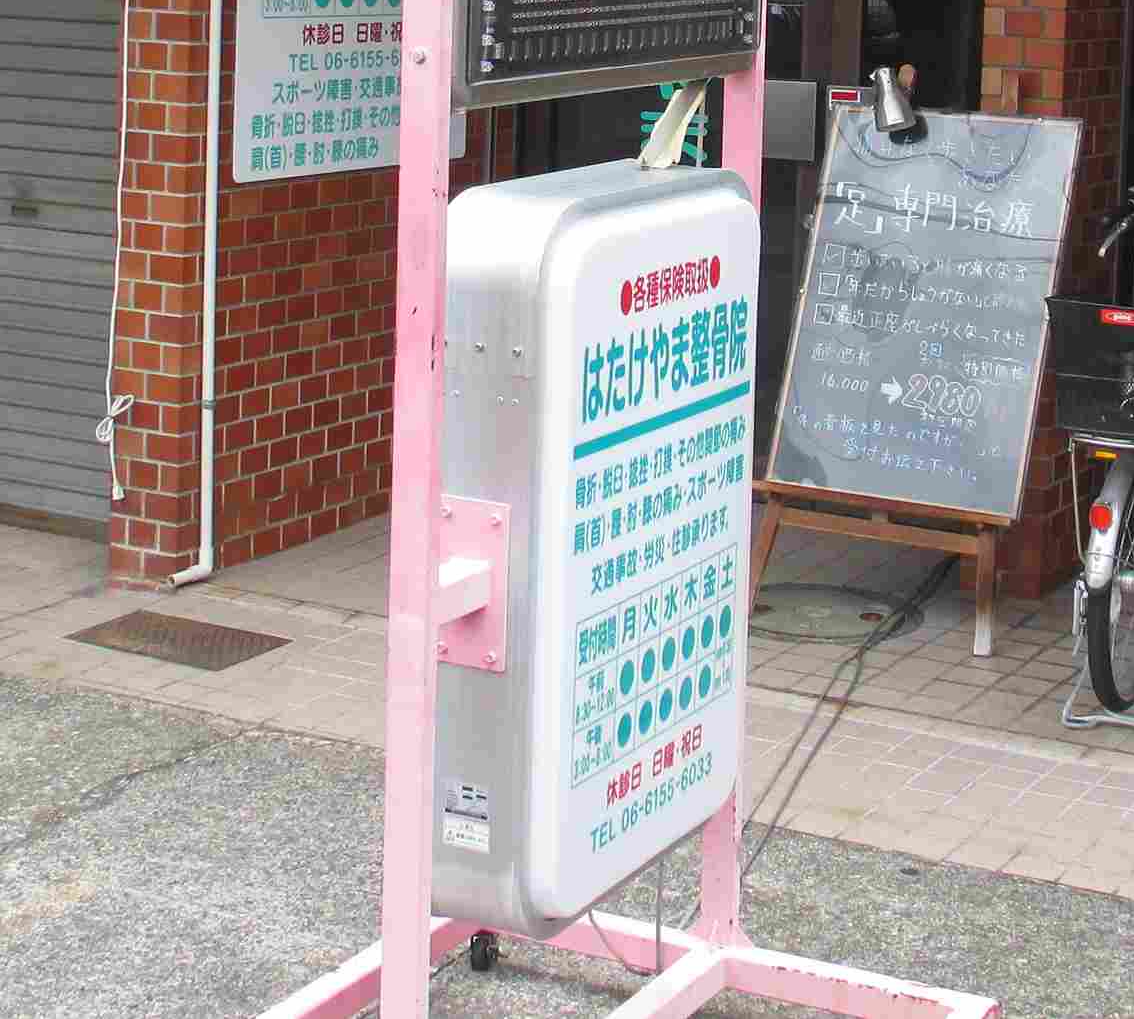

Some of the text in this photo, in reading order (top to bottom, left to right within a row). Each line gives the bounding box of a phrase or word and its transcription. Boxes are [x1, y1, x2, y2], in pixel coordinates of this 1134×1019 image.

[302, 23, 345, 46] 休診日
[289, 52, 320, 73] TEL
[633, 258, 709, 313] 各種保険取扱
[582, 294, 748, 424] はたけやま整骨院
[578, 553, 734, 666] 受付時間 月 火 水 木 金 土
[590, 751, 713, 855] TEL 06-6155-6033
[607, 762, 642, 808] 休診日
